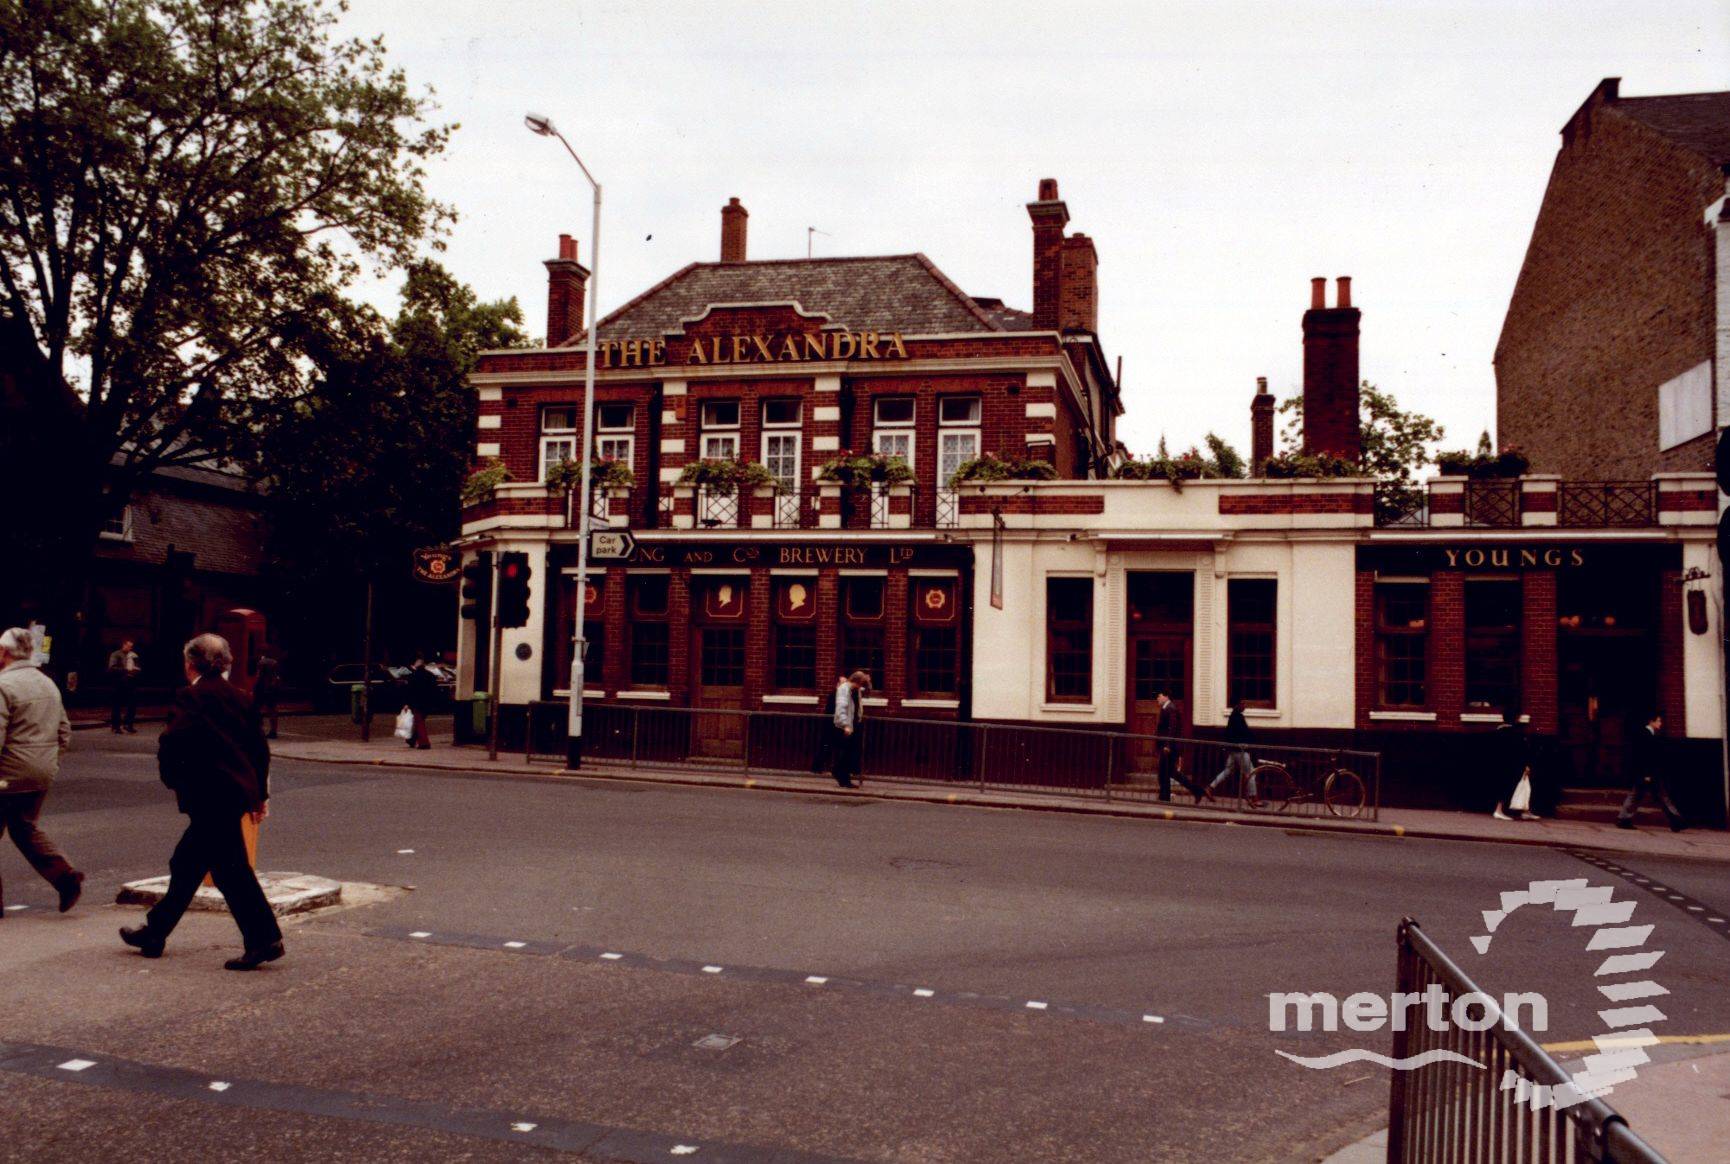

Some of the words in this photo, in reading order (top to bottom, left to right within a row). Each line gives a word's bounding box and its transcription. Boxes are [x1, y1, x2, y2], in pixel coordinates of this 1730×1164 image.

[600, 339, 666, 368] THE
[687, 331, 909, 365] ALEXANDRA
[599, 535, 616, 545] Car
[596, 545, 617, 556] park
[683, 551, 713, 563] AND
[779, 547, 868, 564] BREWERY
[1445, 550, 1585, 567] YOUNGS
